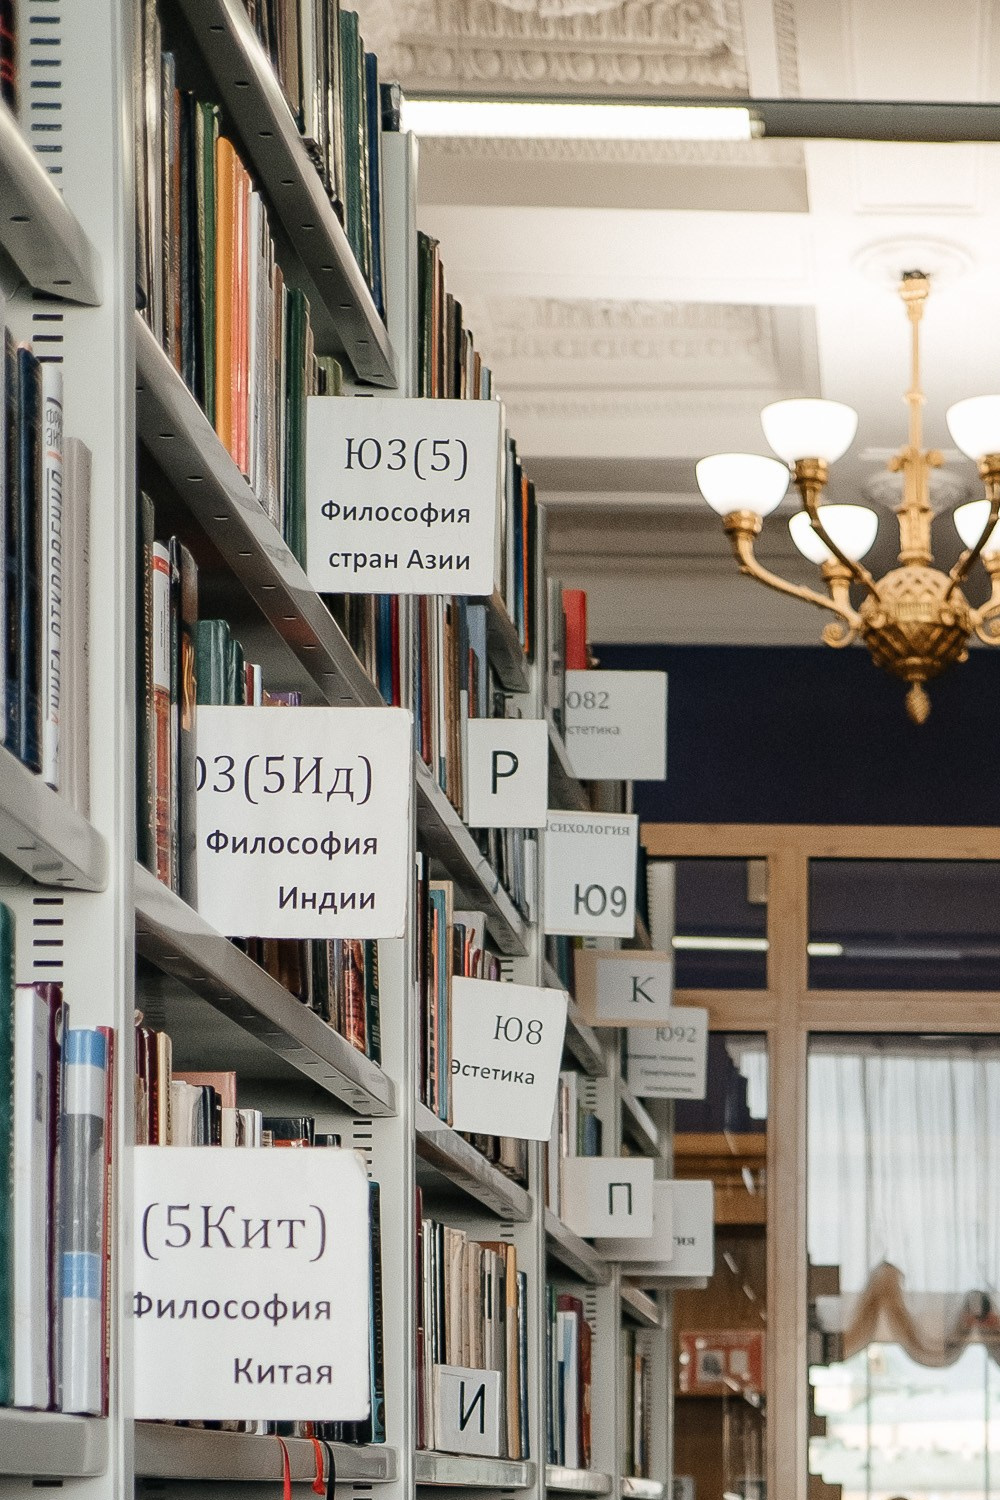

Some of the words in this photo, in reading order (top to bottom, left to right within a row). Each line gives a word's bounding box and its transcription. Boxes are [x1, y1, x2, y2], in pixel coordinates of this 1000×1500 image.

[321, 500, 469, 527] Философия
[329, 553, 397, 572] стран
[407, 550, 469, 570] Азии
[567, 726, 620, 736] стетика
[492, 751, 518, 794] Р
[207, 830, 377, 860] Философия
[279, 886, 375, 914] Индии
[575, 884, 626, 917] Ю9
[632, 976, 653, 1002] К
[494, 1016, 543, 1044] Ю8
[609, 1183, 632, 1215] П
[132, 1291, 332, 1325] Философия
[235, 1358, 332, 1384] Китая
[460, 1382, 485, 1434] И
